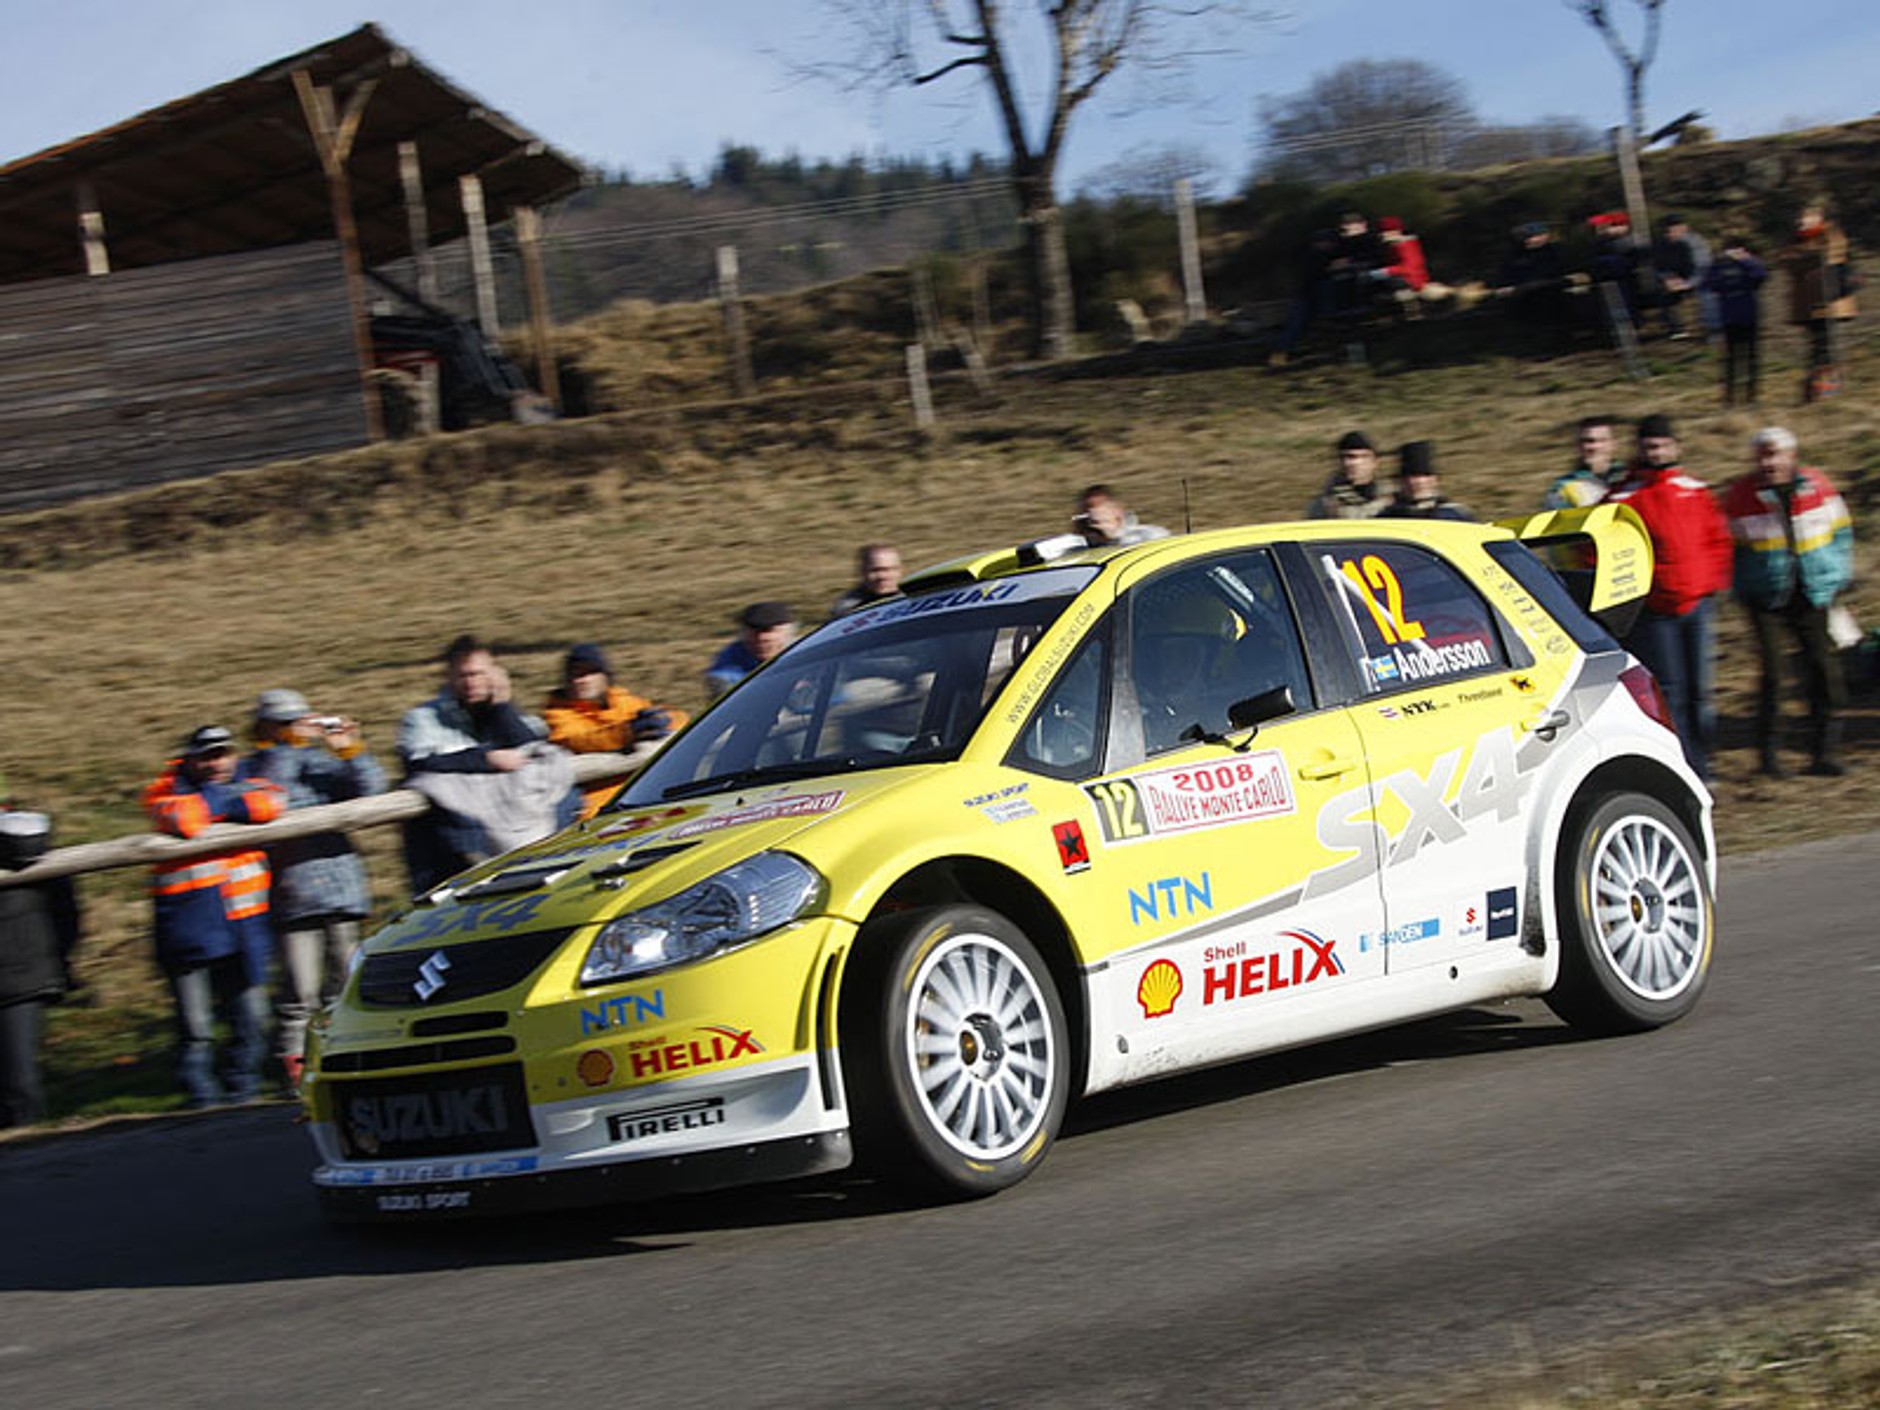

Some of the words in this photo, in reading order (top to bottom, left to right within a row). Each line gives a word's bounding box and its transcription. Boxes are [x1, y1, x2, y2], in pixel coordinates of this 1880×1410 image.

[1341, 554, 1427, 646] 12
[1392, 640, 1492, 682] Andersson
[1401, 699, 1437, 717] NYK
[1148, 784, 1200, 827] RALLYE
[1201, 791, 1245, 818] MONTE
[1243, 765, 1288, 812] CARLO
[1172, 763, 1254, 793] 2008
[1092, 779, 1145, 840] 12
[1304, 728, 1535, 898] SX4
[393, 892, 553, 946] SX4
[1128, 872, 1215, 926] NTN
[1203, 941, 1248, 964] Shell
[1203, 931, 1344, 1006] HELIX
[579, 988, 666, 1035] NTN
[630, 1026, 764, 1079] HELIX
[349, 1088, 510, 1144] SUZUKI
[607, 1096, 726, 1142] PIRELLI
